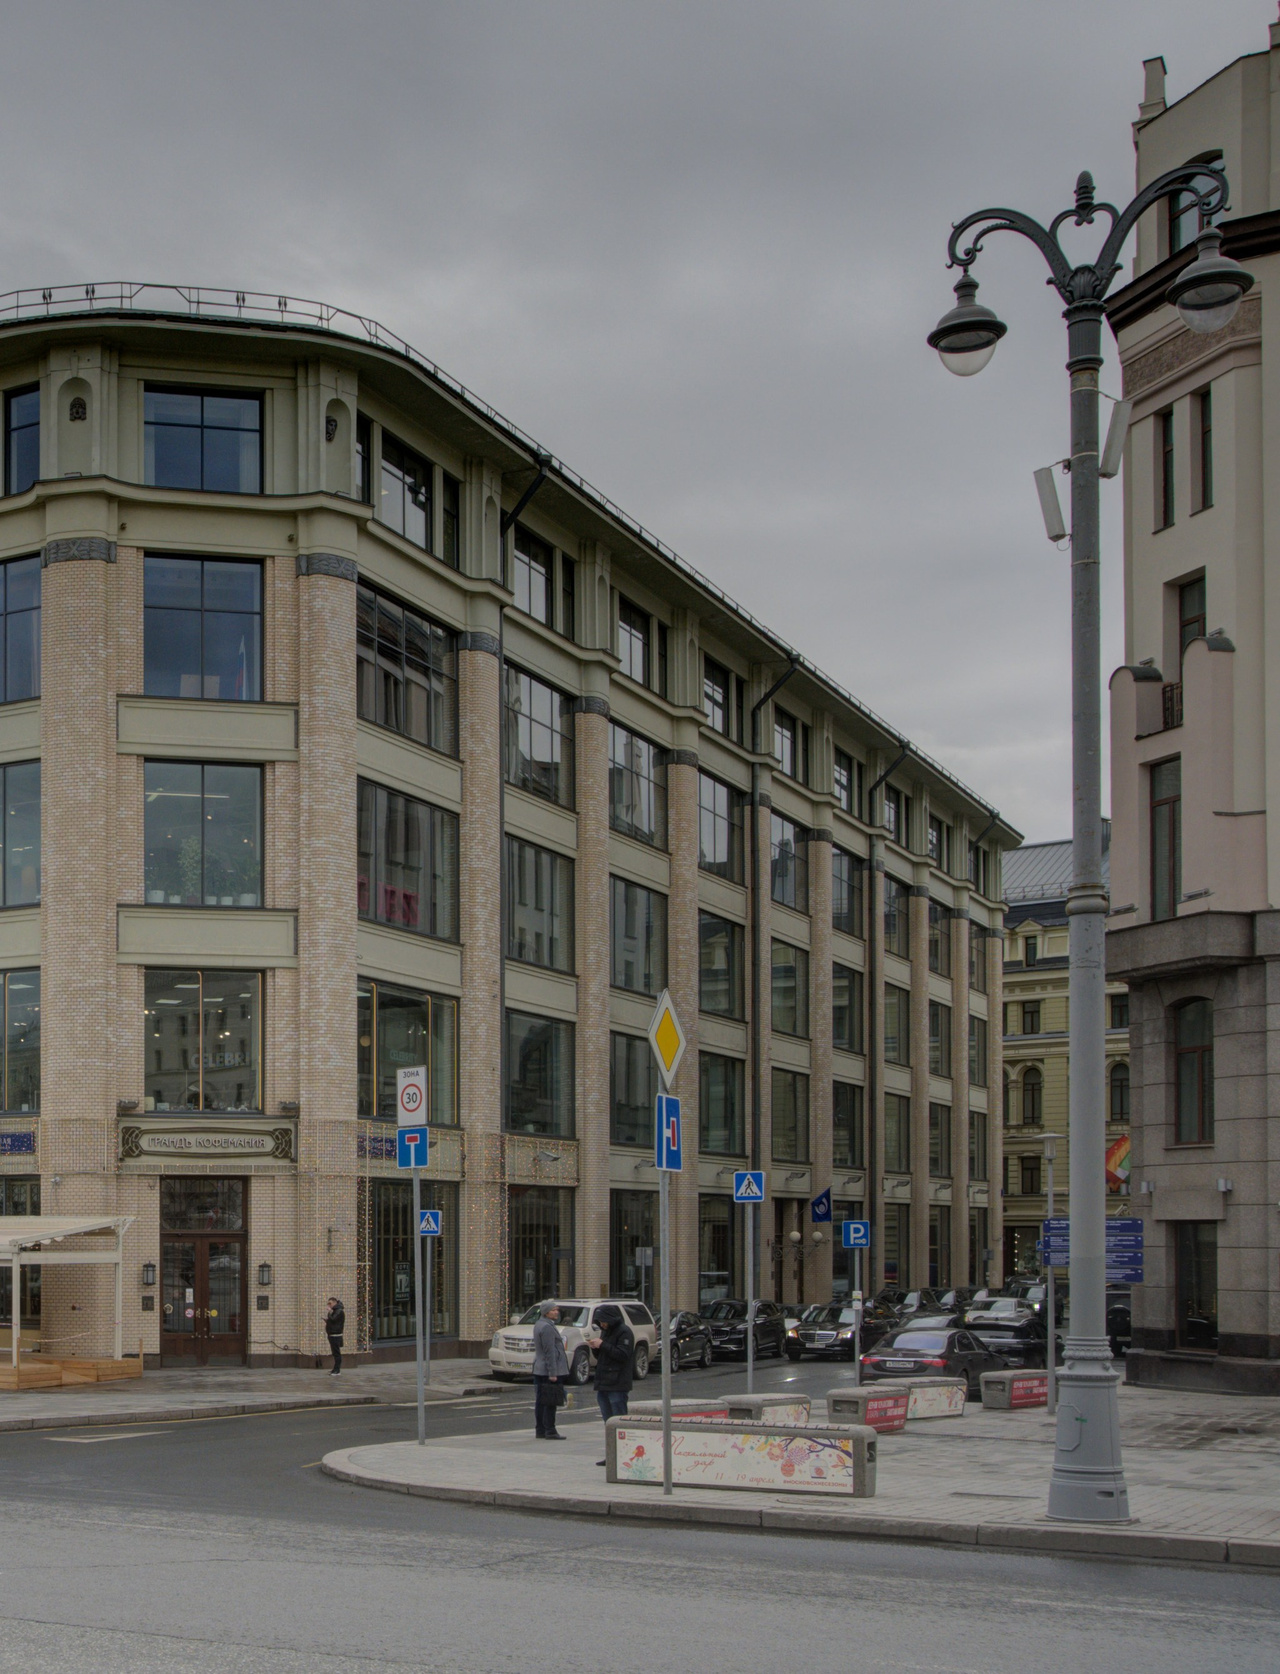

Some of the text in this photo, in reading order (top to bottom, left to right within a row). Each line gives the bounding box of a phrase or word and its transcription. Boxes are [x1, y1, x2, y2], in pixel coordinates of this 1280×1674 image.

[402, 1070, 419, 1079] ЗОНА
[405, 1092, 418, 1104] 30
[195, 1136, 267, 1149] КОФЕМАНИЯ
[849, 1223, 865, 1245] P
[686, 1459, 715, 1473] дар
[736, 1473, 747, 1481] 19
[749, 1477, 775, 1486] апреля
